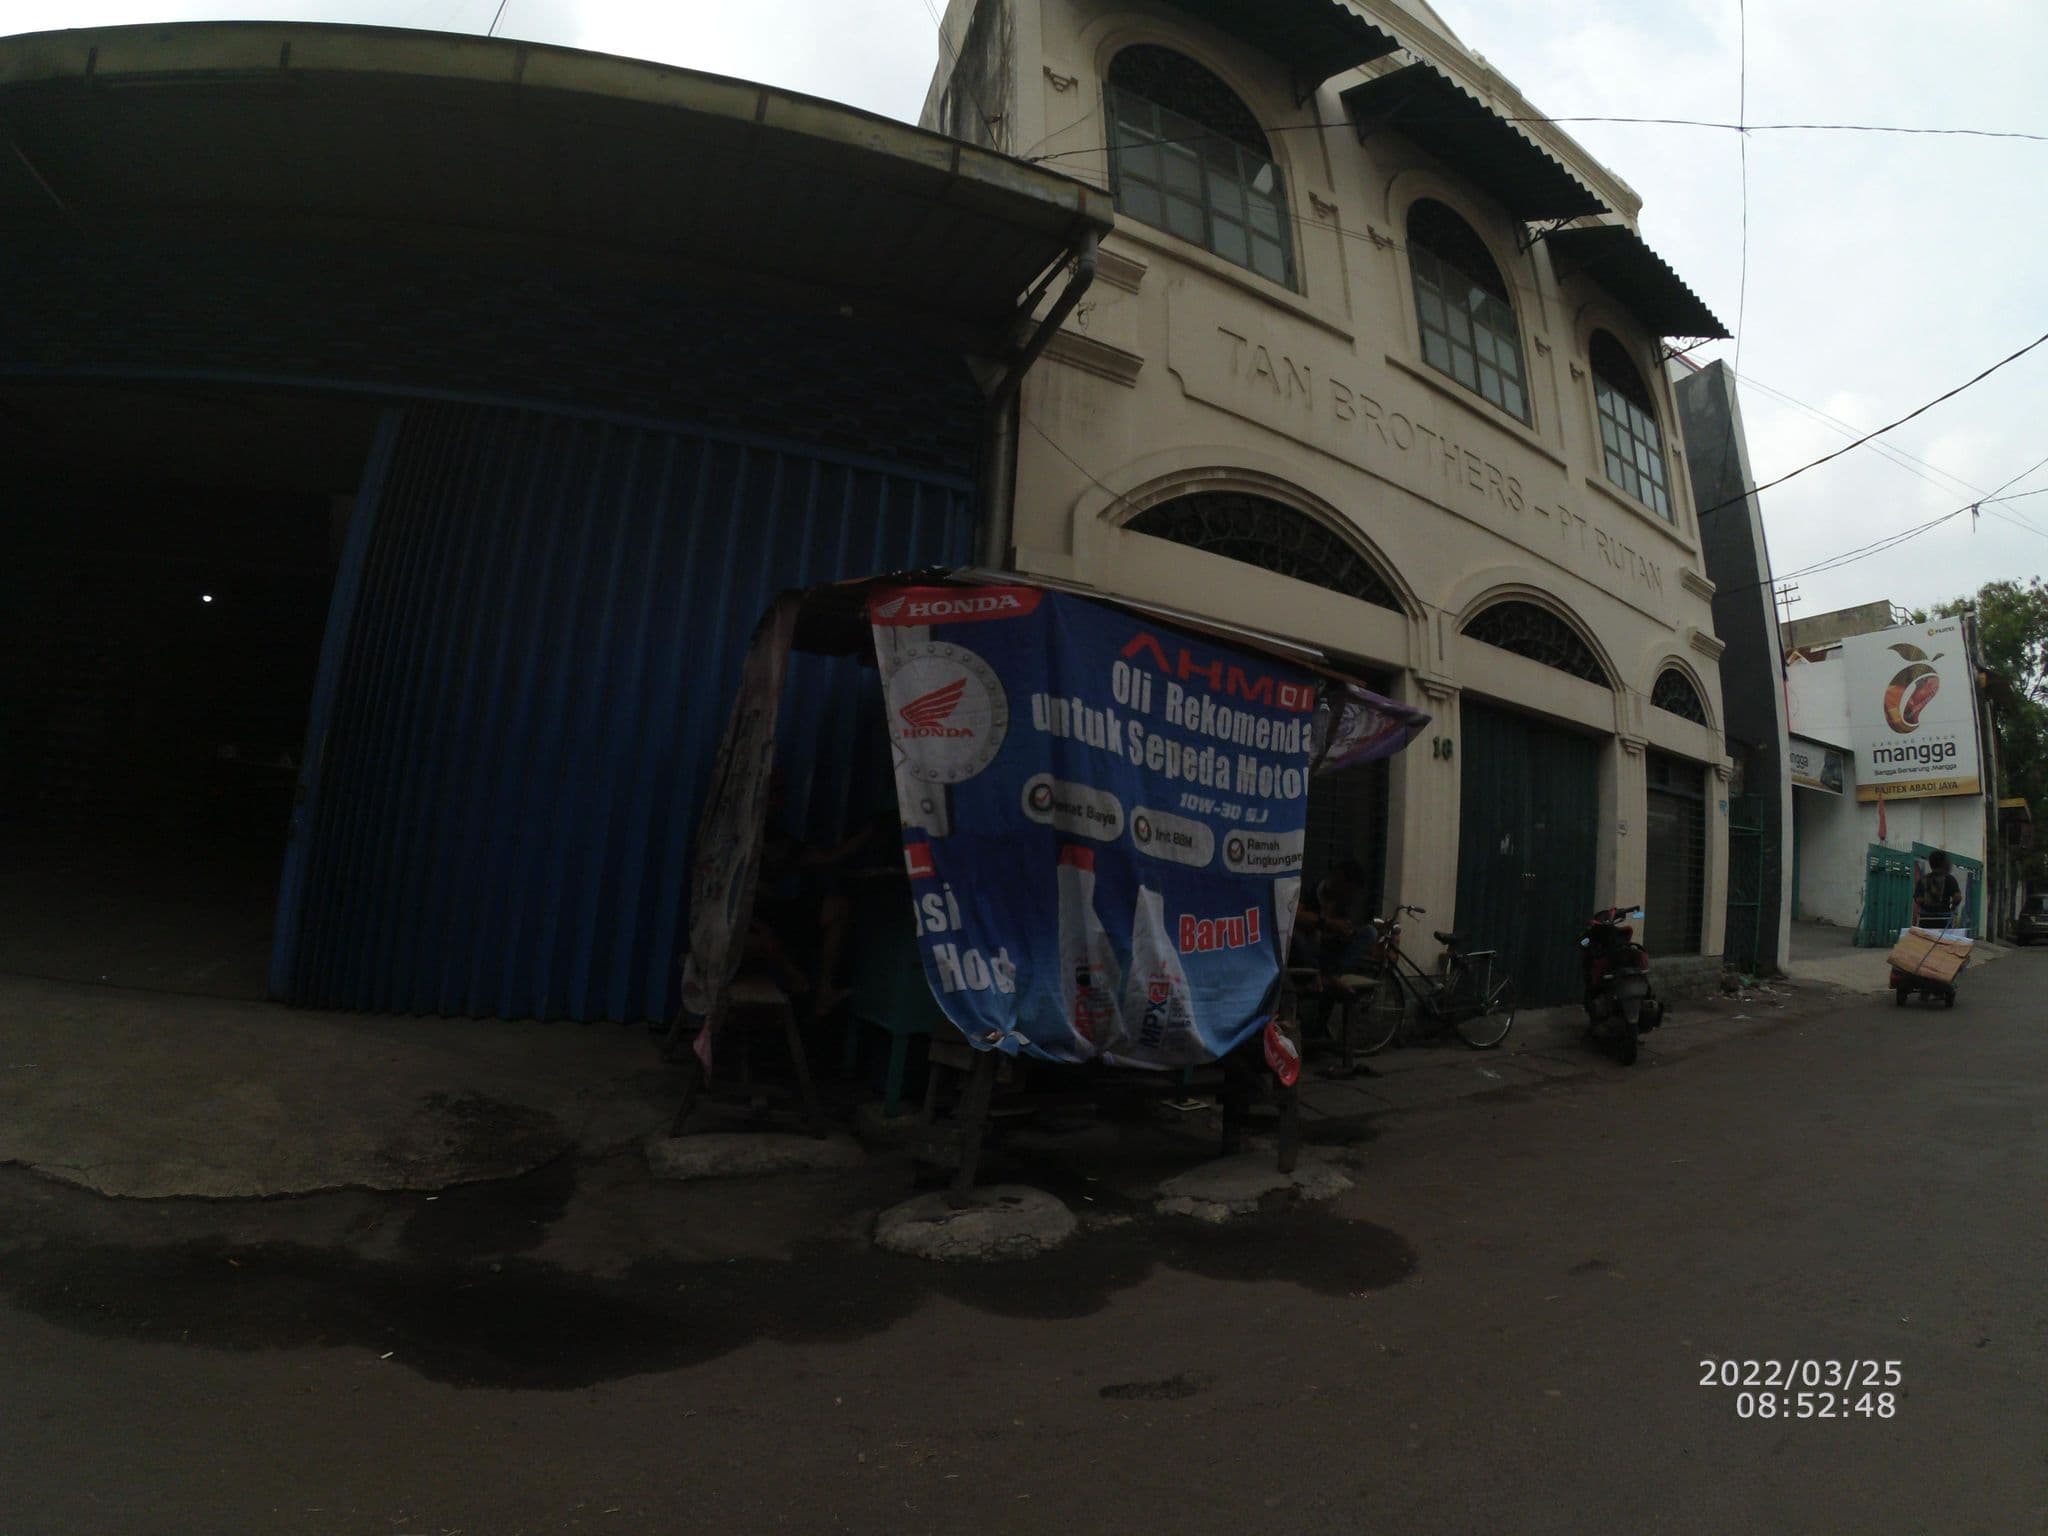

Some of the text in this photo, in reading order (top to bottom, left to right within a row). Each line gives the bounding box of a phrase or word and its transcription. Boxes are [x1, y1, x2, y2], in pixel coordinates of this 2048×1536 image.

[1217, 325, 1313, 413] TAN
[1328, 377, 1527, 513] BROTHERS
[1557, 504, 1588, 551] PT
[1595, 527, 1663, 598] RUTAN
[906, 593, 1022, 618] HONDA
[1111, 659, 1153, 714] Oli
[903, 726, 975, 739] HONDA
[1030, 692, 1124, 757] untuk
[1127, 719, 1231, 790] Sepeda
[1872, 741, 1957, 764] mangga
